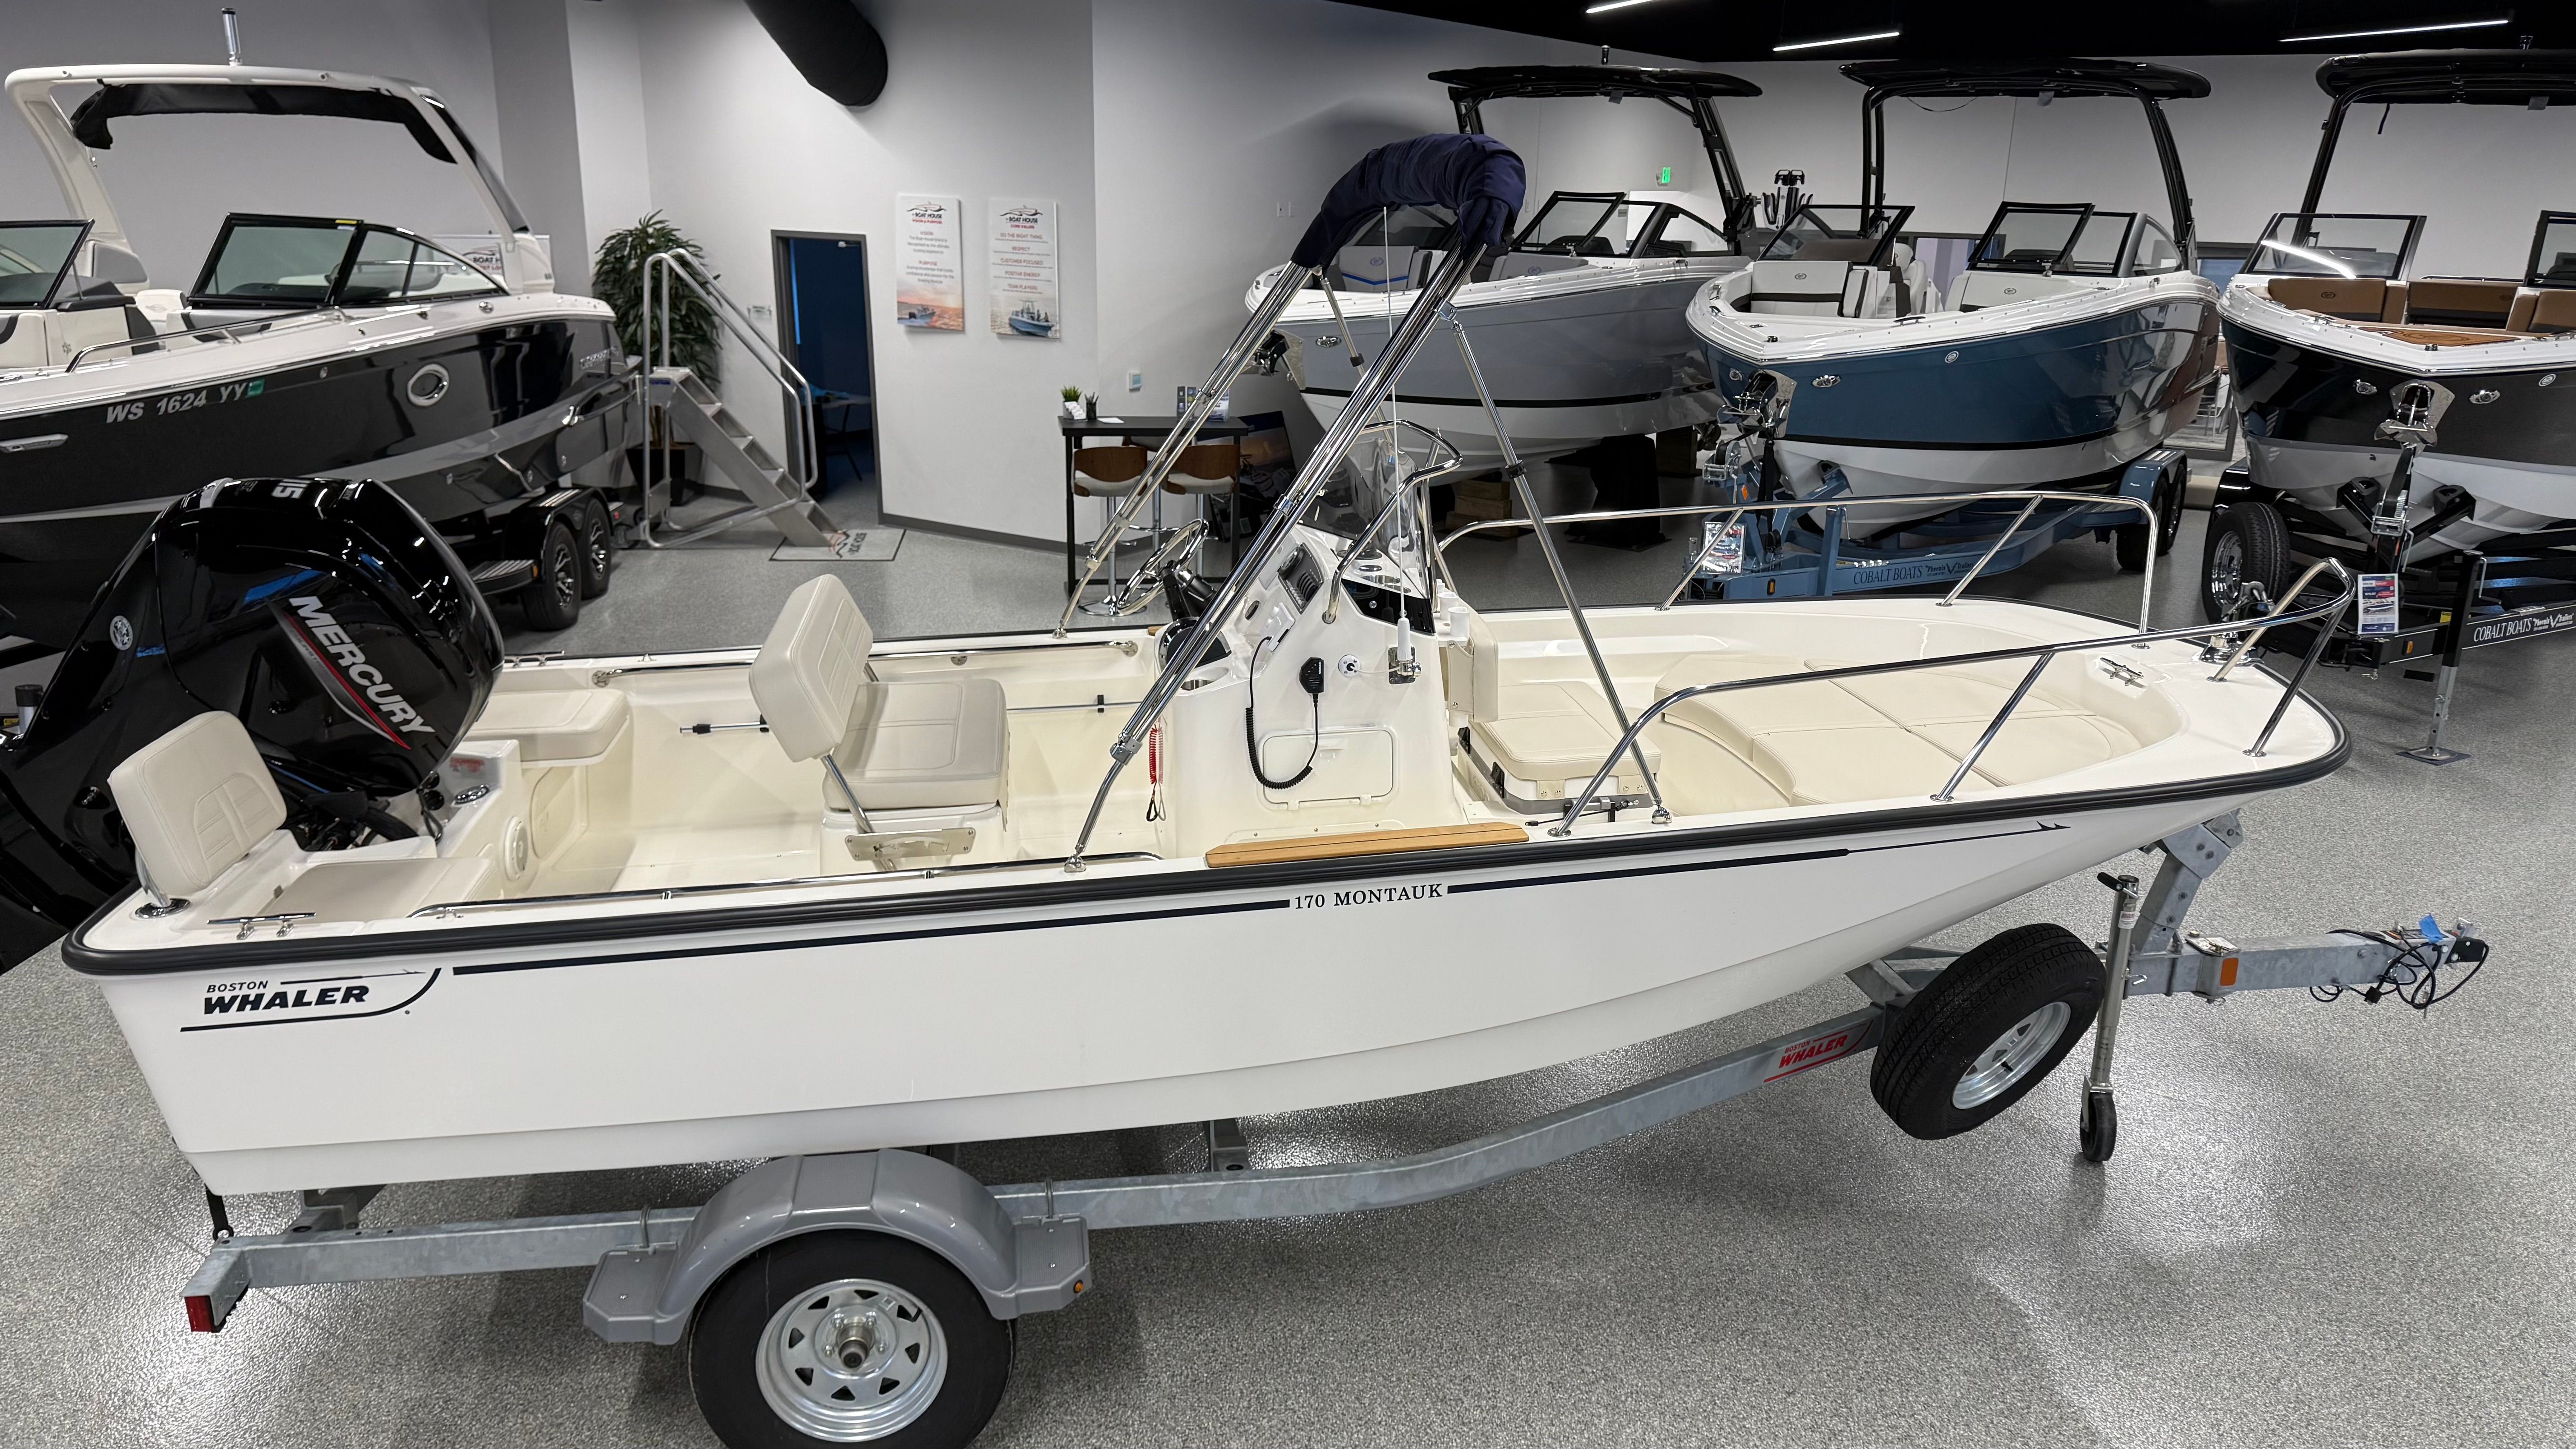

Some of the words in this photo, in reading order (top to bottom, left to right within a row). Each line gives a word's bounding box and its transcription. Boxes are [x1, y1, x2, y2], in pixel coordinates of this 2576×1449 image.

[106, 402, 144, 423] WS
[157, 390, 208, 415] 1624
[219, 383, 247, 403] YY
[271, 478, 312, 499] 115
[1854, 568, 1892, 584] COBALT
[1893, 565, 1923, 580] BOATS
[2473, 622, 2507, 642] COBALT
[2506, 617, 2533, 636] BOATS
[289, 595, 436, 733] MERCURY
[1295, 894, 1325, 909] 170
[1334, 883, 1443, 906] MONTAUK
[206, 980, 268, 993] BOSTON
[203, 985, 369, 1015] WHALER
[1778, 1034, 1849, 1069] WHALER
[1785, 1039, 1811, 1054] BOSTON
